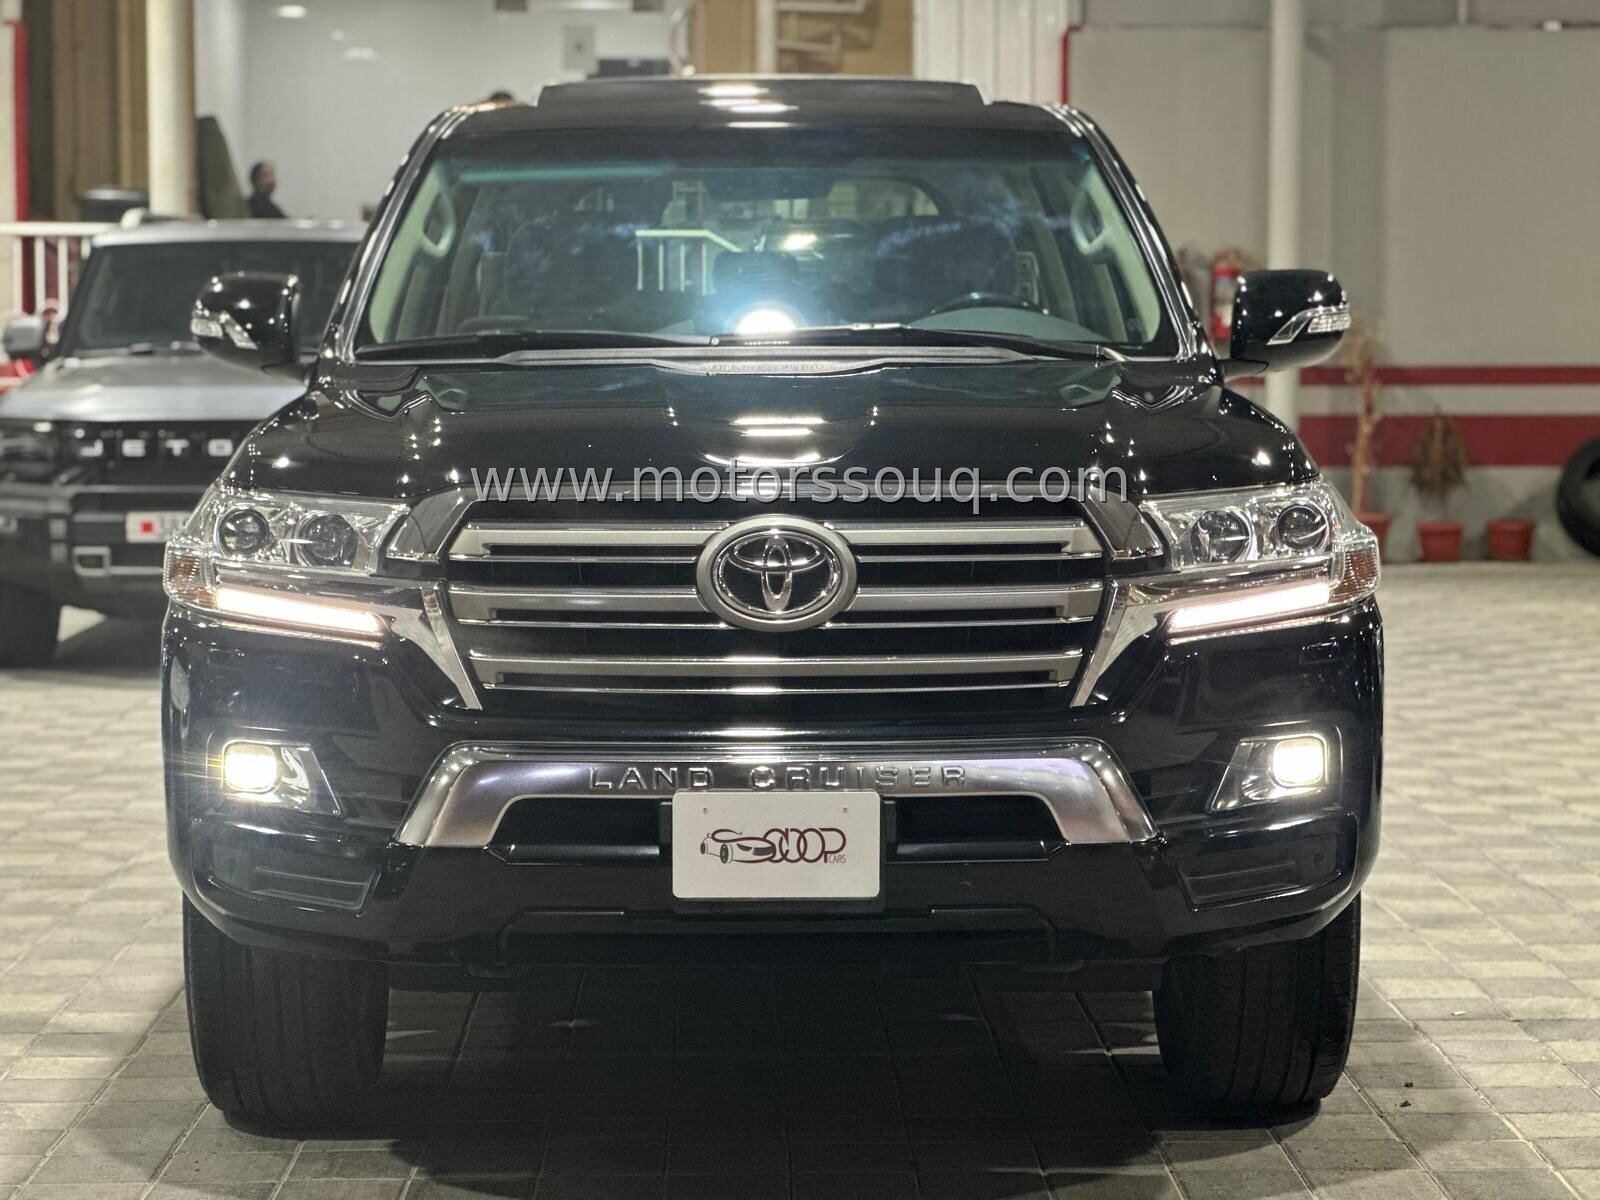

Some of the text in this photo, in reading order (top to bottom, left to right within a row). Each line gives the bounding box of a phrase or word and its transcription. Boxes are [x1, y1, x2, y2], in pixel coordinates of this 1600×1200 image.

[589, 765, 966, 790] LAND CRUISER
[828, 854, 847, 864] CARS
